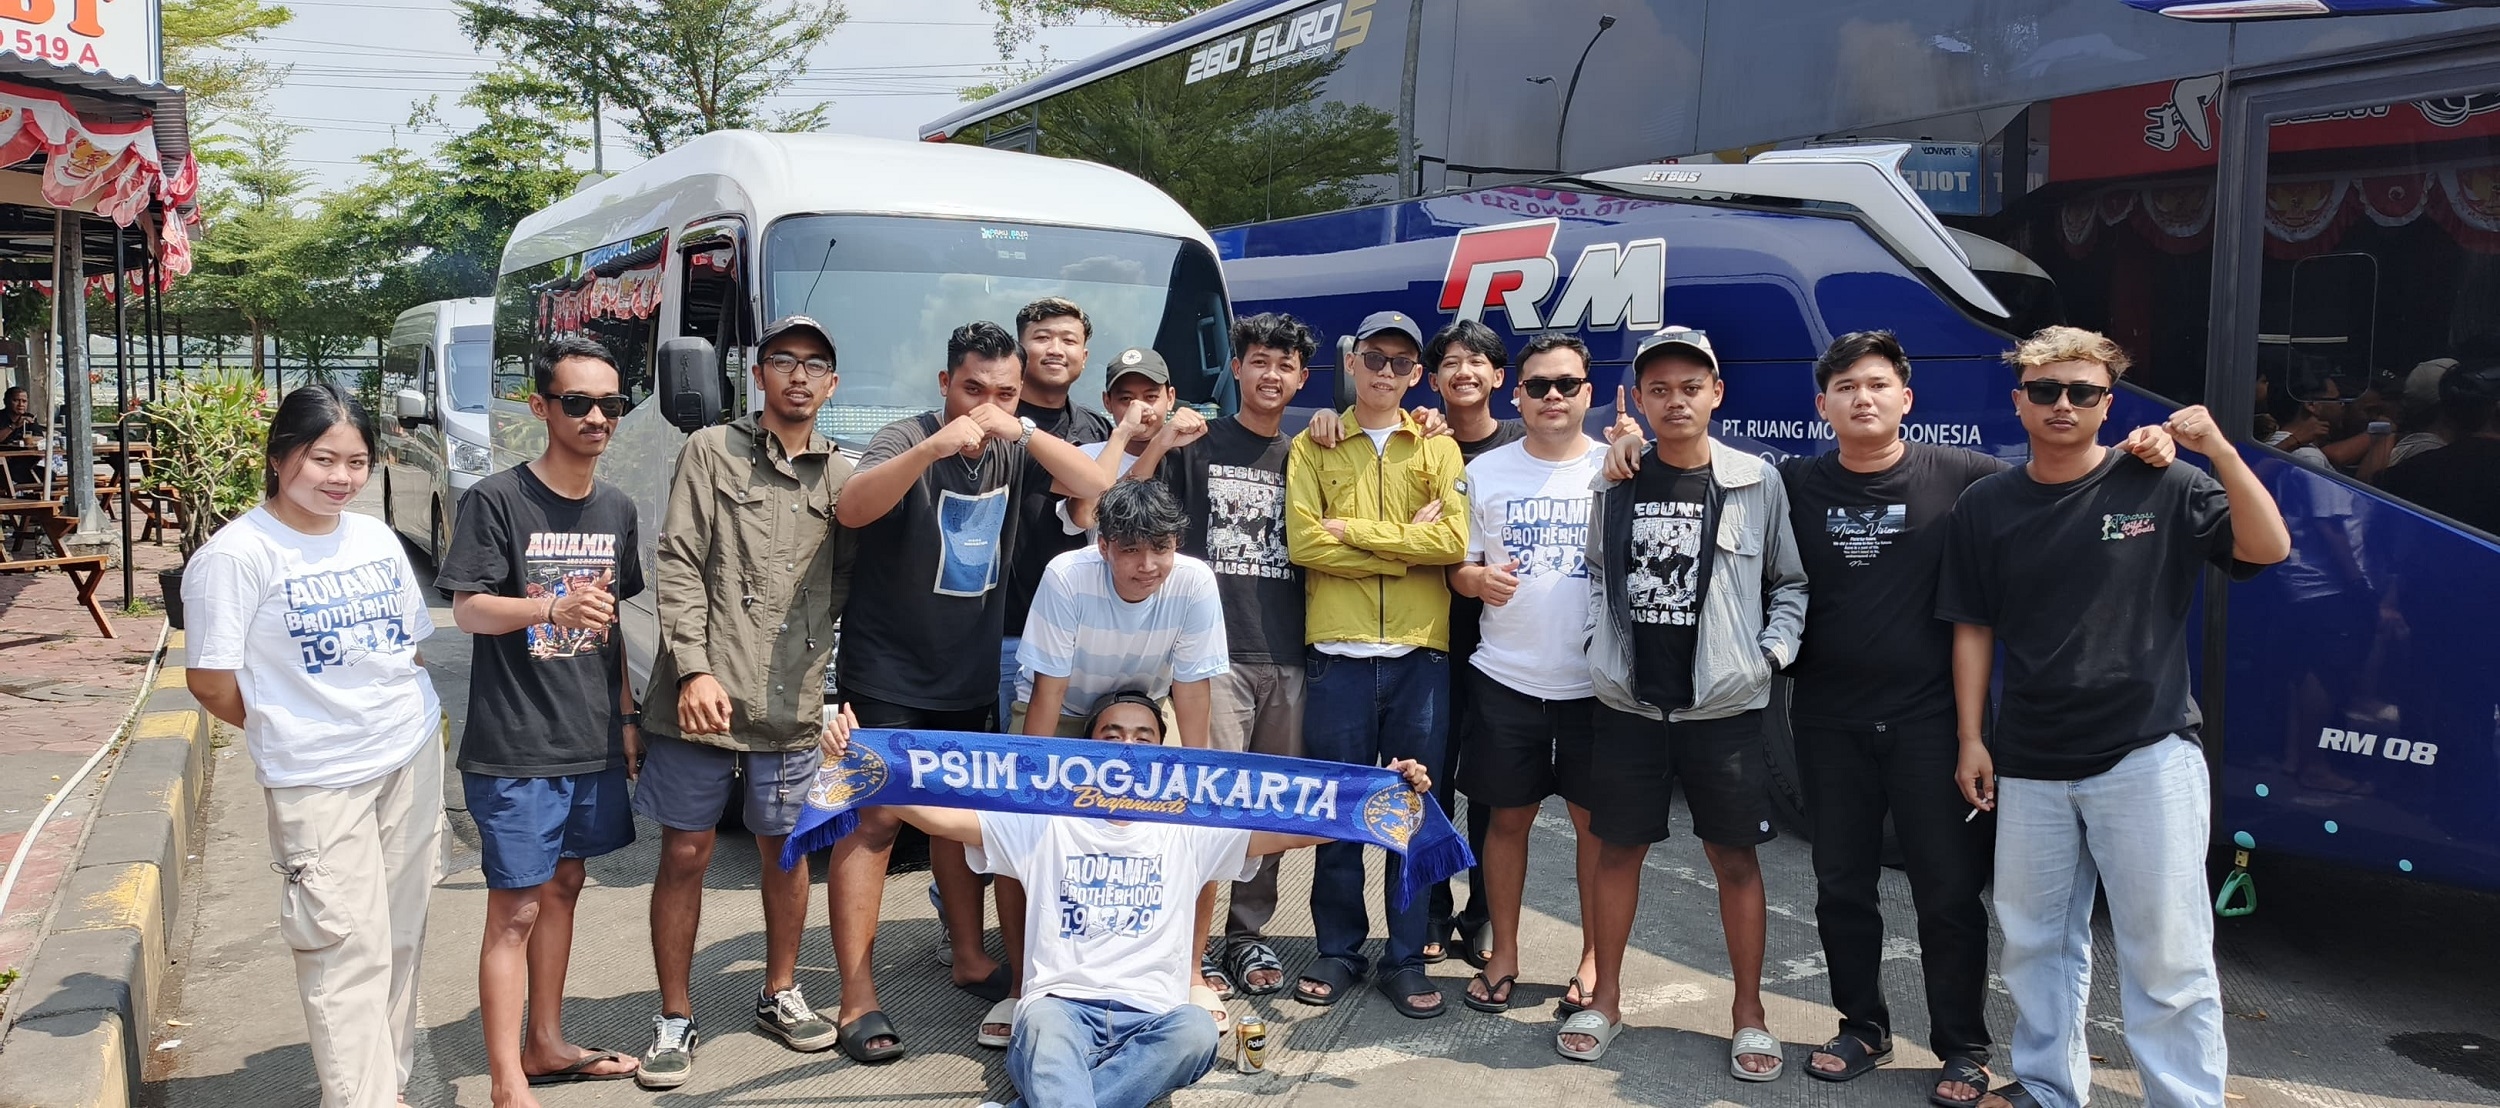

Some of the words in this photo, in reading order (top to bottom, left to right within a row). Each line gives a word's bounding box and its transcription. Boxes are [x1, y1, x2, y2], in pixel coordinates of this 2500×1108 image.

[15, 29, 69, 61] 519
[78, 43, 100, 68] A
[1185, 36, 1246, 85] 280
[1246, 63, 1264, 78] AIR
[1265, 43, 1332, 72] SUSPENSION
[1642, 170, 1701, 183] JETBUS
[1437, 216, 1666, 336] RM
[1722, 418, 1744, 438] PT.
[1747, 420, 1804, 440] RUANG
[1898, 422, 1982, 445] DONESIA
[525, 532, 616, 557] AQUAMIX
[2318, 727, 2378, 756] RM
[2383, 737, 2439, 766] 08
[907, 749, 1019, 790] PSIM
[1031, 754, 1340, 821] JOGJAKARTA
[1060, 880, 1163, 909] BROTHERHOOD
[1060, 906, 1087, 937] 19
[1121, 908, 1154, 937] 29
